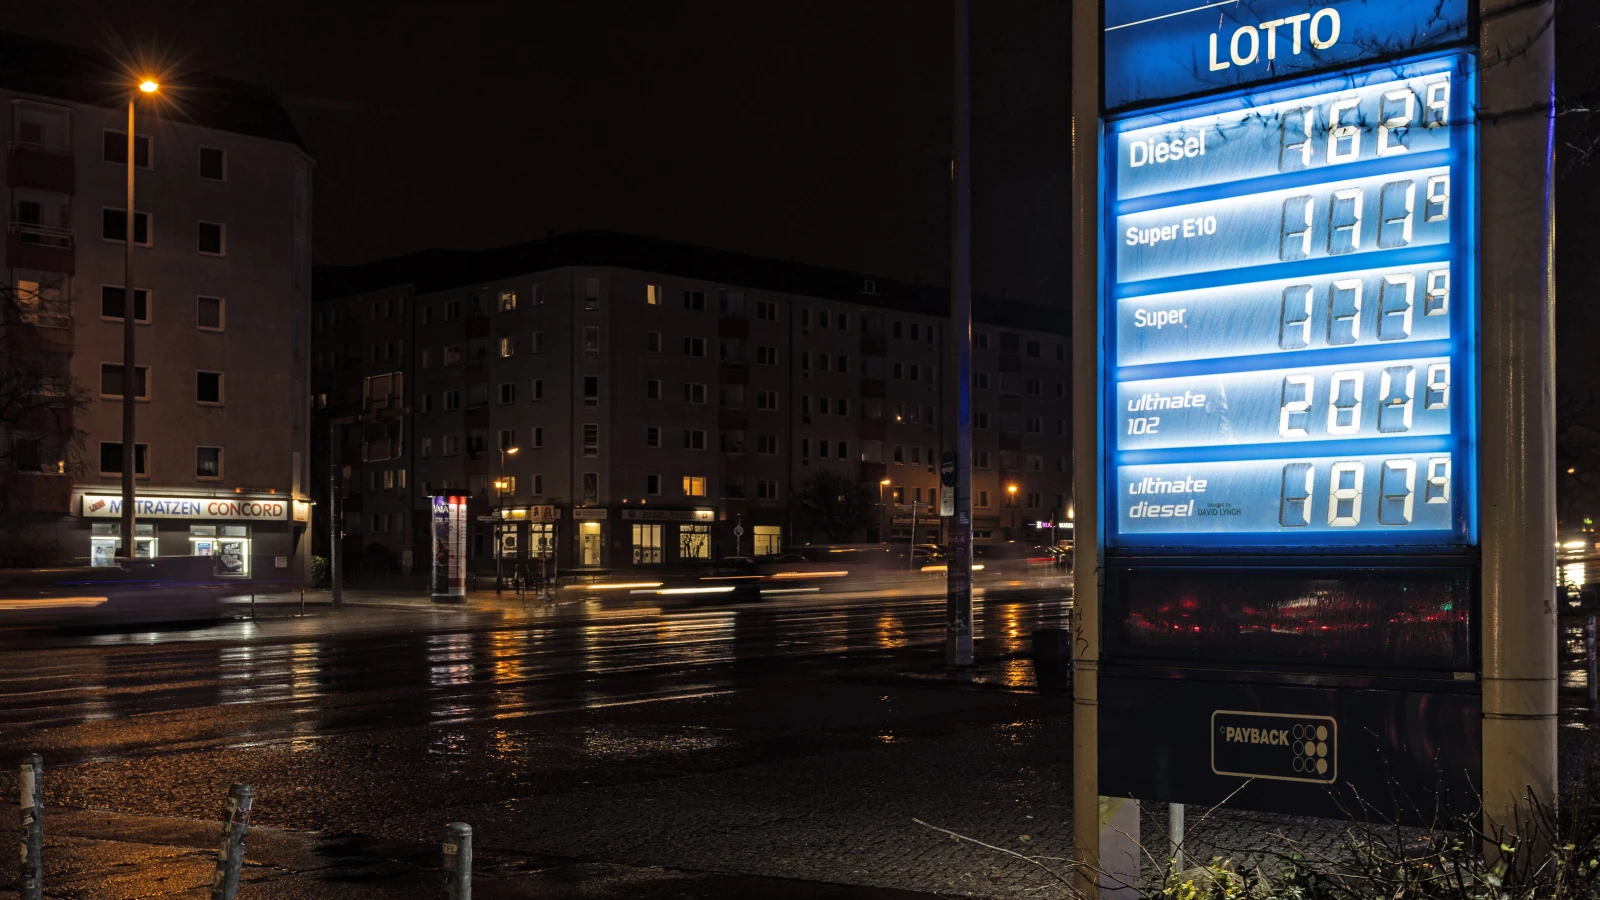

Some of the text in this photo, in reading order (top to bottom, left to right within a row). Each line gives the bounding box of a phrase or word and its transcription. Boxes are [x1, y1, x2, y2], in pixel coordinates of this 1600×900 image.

[1209, 8, 1341, 71] LOTTO
[1130, 128, 1205, 167] Diesel
[1126, 216, 1217, 246] Super E10
[1134, 308, 1186, 330] Super
[1127, 391, 1206, 412] ultimate
[1127, 417, 1160, 435] 102
[1129, 476, 1207, 494] ultimate
[109, 500, 201, 516] MTRATZEN
[207, 502, 283, 517] CONCORD
[1129, 500, 1194, 518] diesel
[1197, 508, 1242, 516] DAVID LYNCH
[1226, 727, 1289, 745] PAYBACK
